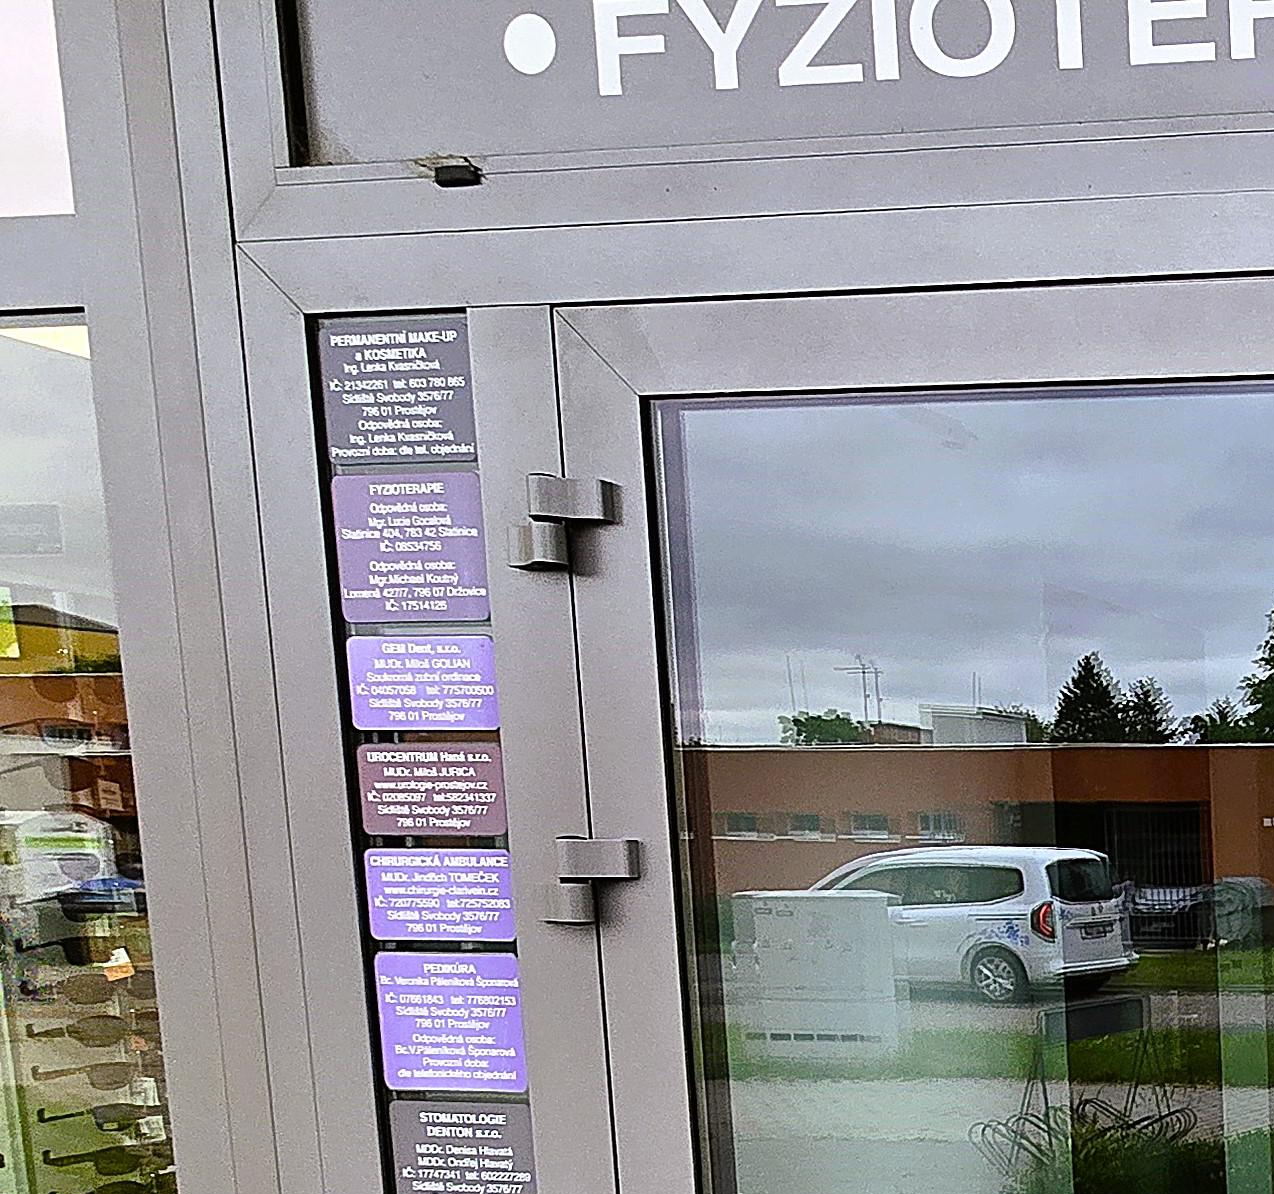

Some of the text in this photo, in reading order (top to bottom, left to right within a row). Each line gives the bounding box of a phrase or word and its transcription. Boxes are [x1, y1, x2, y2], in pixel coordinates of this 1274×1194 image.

[408, 331, 457, 343] MAKE-UP
[364, 348, 427, 360] KOSMETIKA
[381, 406, 392, 416] 01
[369, 483, 444, 495] FYZIOTERAPIE
[408, 711, 419, 720] 01
[416, 818, 427, 827] 01
[443, 856, 508, 867] AMBULANCE
[426, 923, 437, 933] 01
[434, 1019, 445, 1028] 01
[420, 1112, 506, 1125] STOMATOLOGIE
